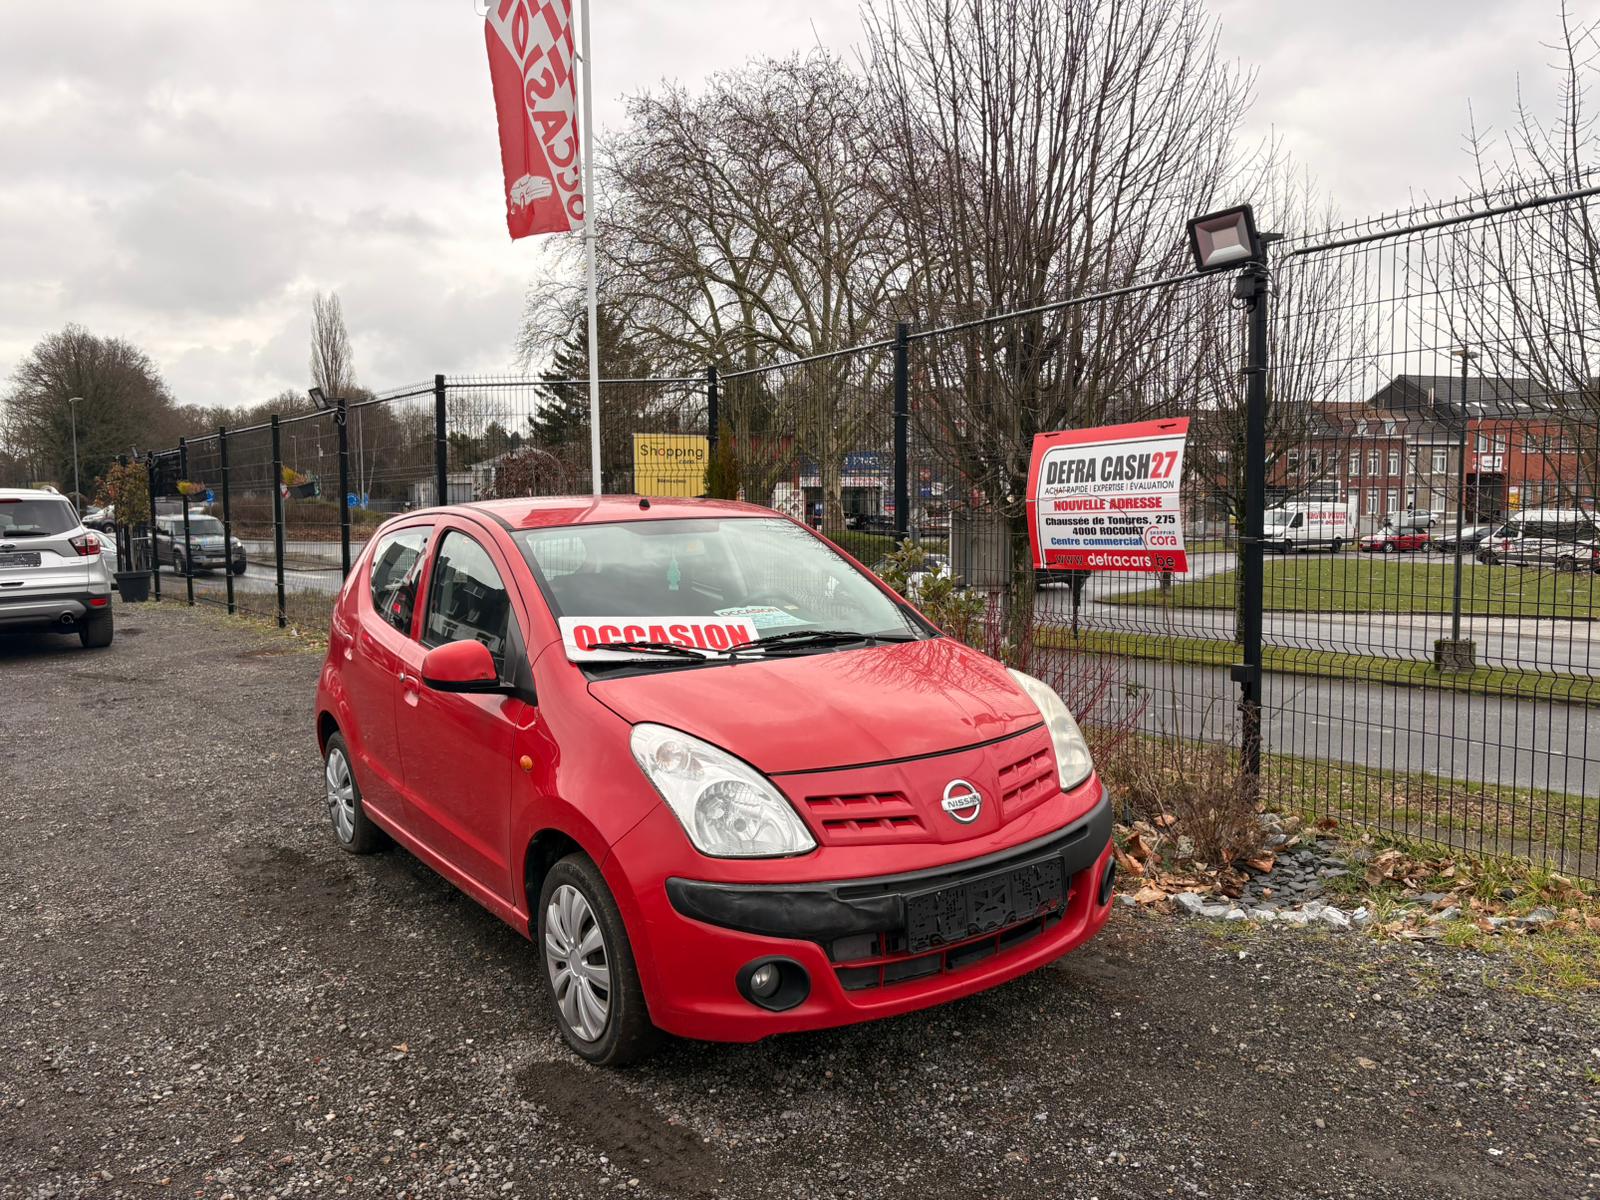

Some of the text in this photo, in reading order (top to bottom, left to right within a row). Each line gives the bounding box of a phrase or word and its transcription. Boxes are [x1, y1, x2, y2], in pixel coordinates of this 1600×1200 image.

[640, 444, 703, 460] Shopping
[1046, 458, 1096, 485] DEFRA
[1093, 482, 1124, 493] EXPERTISE
[1130, 480, 1174, 491] ÉVALUATION
[1054, 497, 1162, 512] NOUVELLE ADRESSE
[1045, 516, 1089, 526] Chaussée
[1092, 516, 1104, 526] de
[1155, 514, 1176, 524] 275
[1072, 526, 1144, 536] 4000 ROCOURT
[1051, 536, 1143, 546] Centre commercial
[1150, 535, 1177, 546] cora
[573, 624, 753, 652] OCCASION
[947, 794, 980, 808] NISSAN
